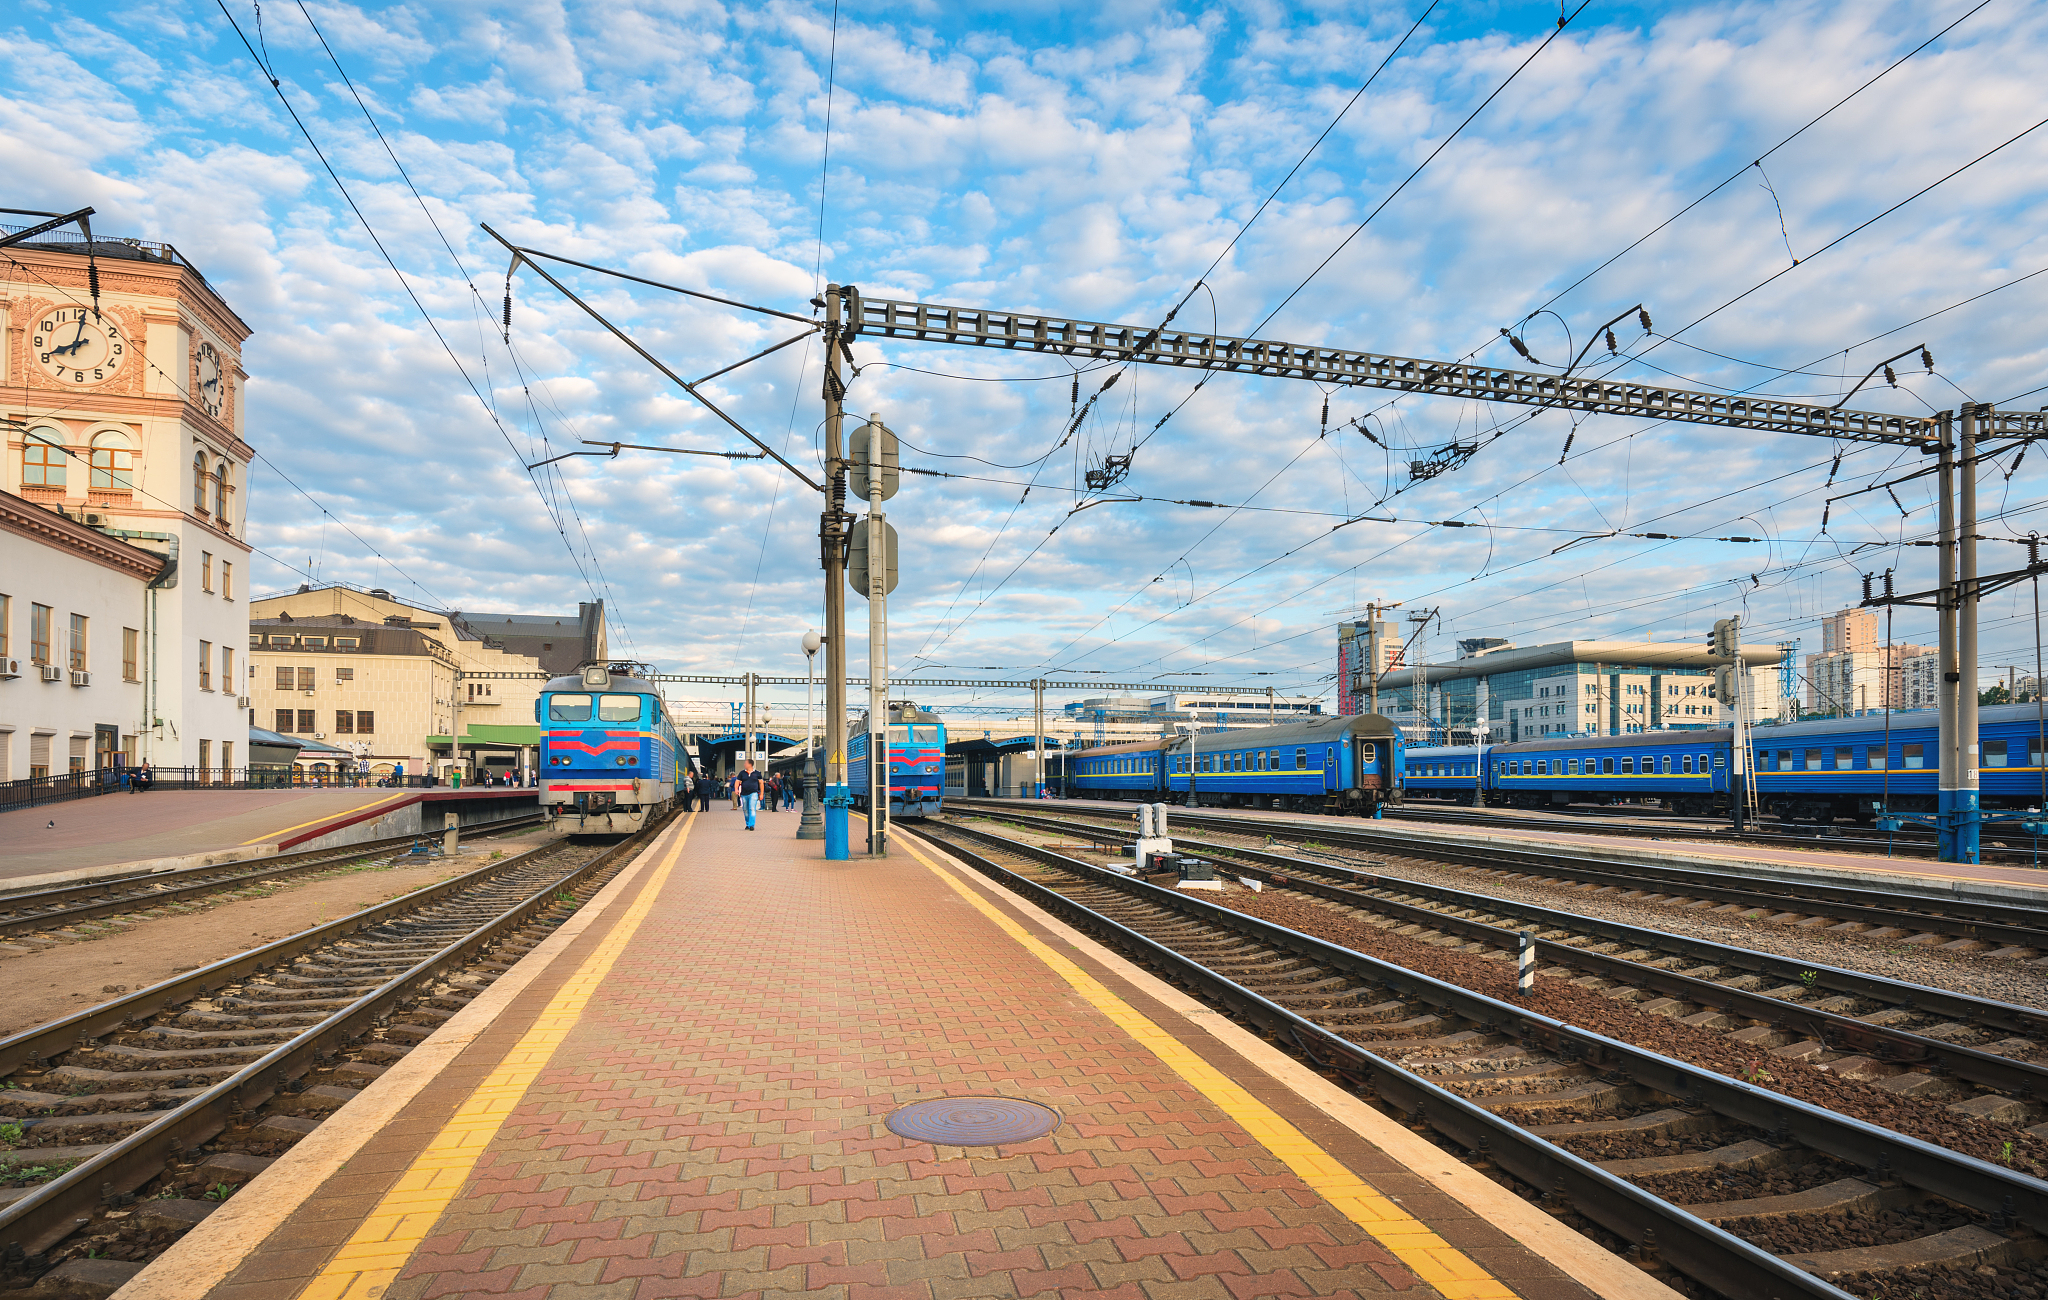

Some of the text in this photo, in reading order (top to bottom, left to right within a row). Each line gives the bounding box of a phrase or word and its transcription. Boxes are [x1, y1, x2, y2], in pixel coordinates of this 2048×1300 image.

[56, 311, 65, 322] 11
[74, 308, 86, 320] 12
[41, 320, 53, 332] 10
[108, 327, 117, 338] 2
[34, 336, 43, 347] 9
[113, 344, 122, 355] 3
[41, 352, 50, 363] 8
[107, 357, 116, 368] 4
[56, 365, 66, 376] 7
[94, 369, 103, 379] 5
[75, 371, 84, 382] 6
